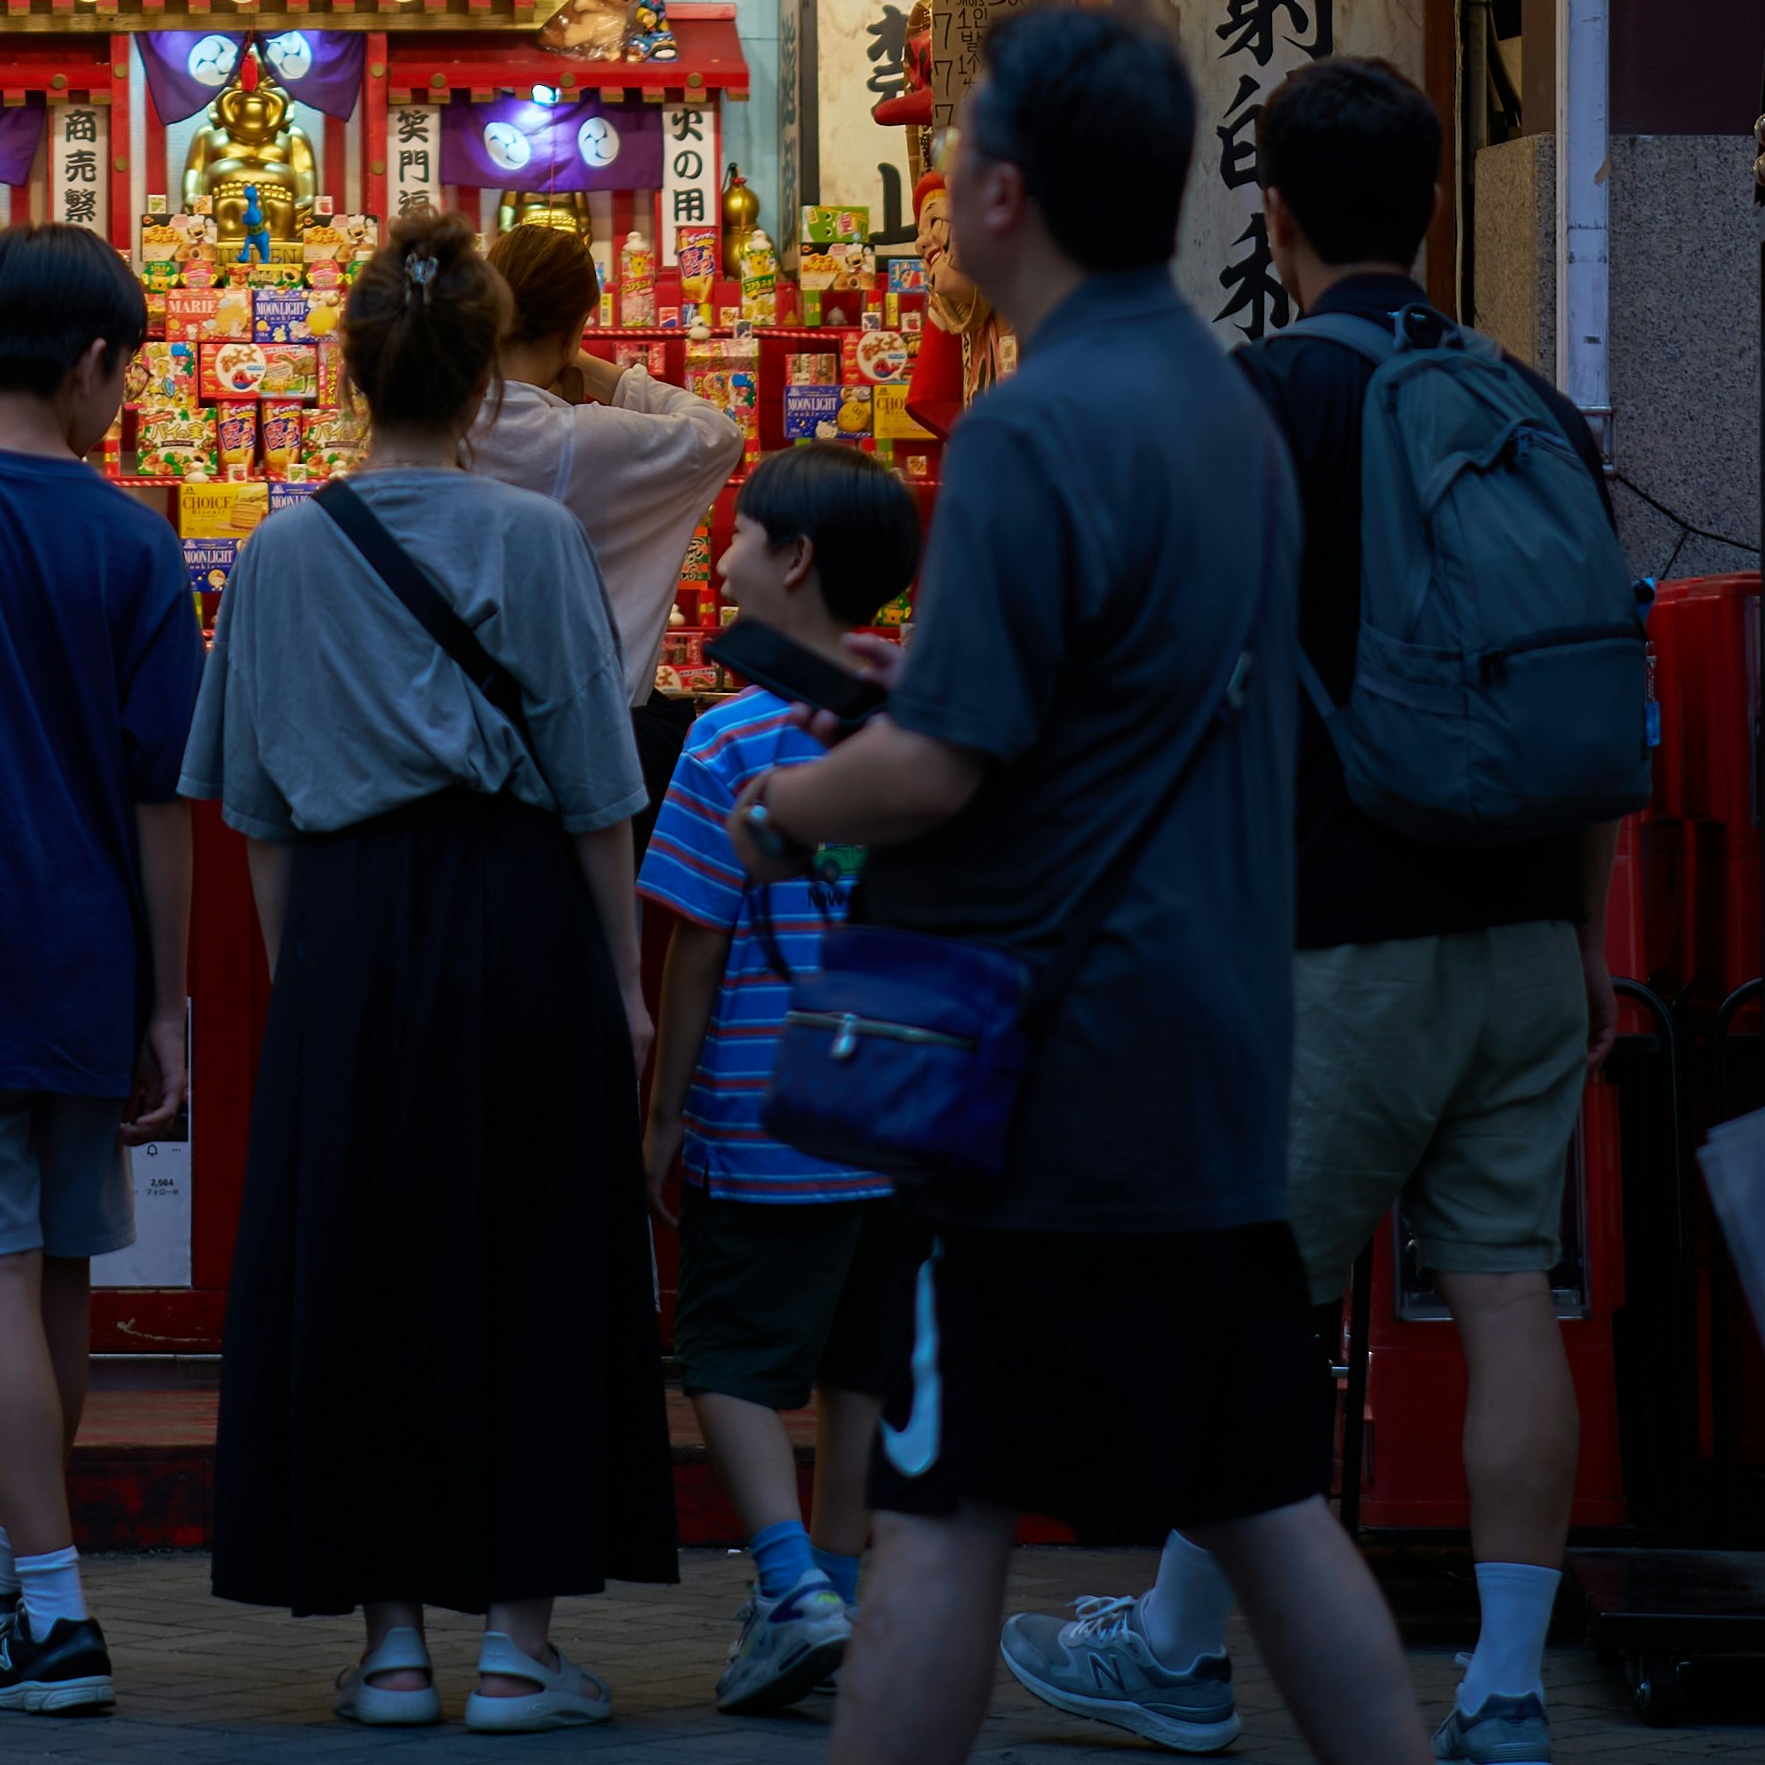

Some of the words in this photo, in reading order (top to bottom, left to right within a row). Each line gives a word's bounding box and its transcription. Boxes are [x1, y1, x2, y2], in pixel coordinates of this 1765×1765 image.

[670, 106, 705, 256] 火の用
[168, 300, 217, 314] MARIE
[255, 301, 306, 315] MOONLIGHT
[787, 397, 836, 410] MOONLIGHT
[151, 421, 205, 441] パイの実
[182, 496, 232, 509] CHOICE
